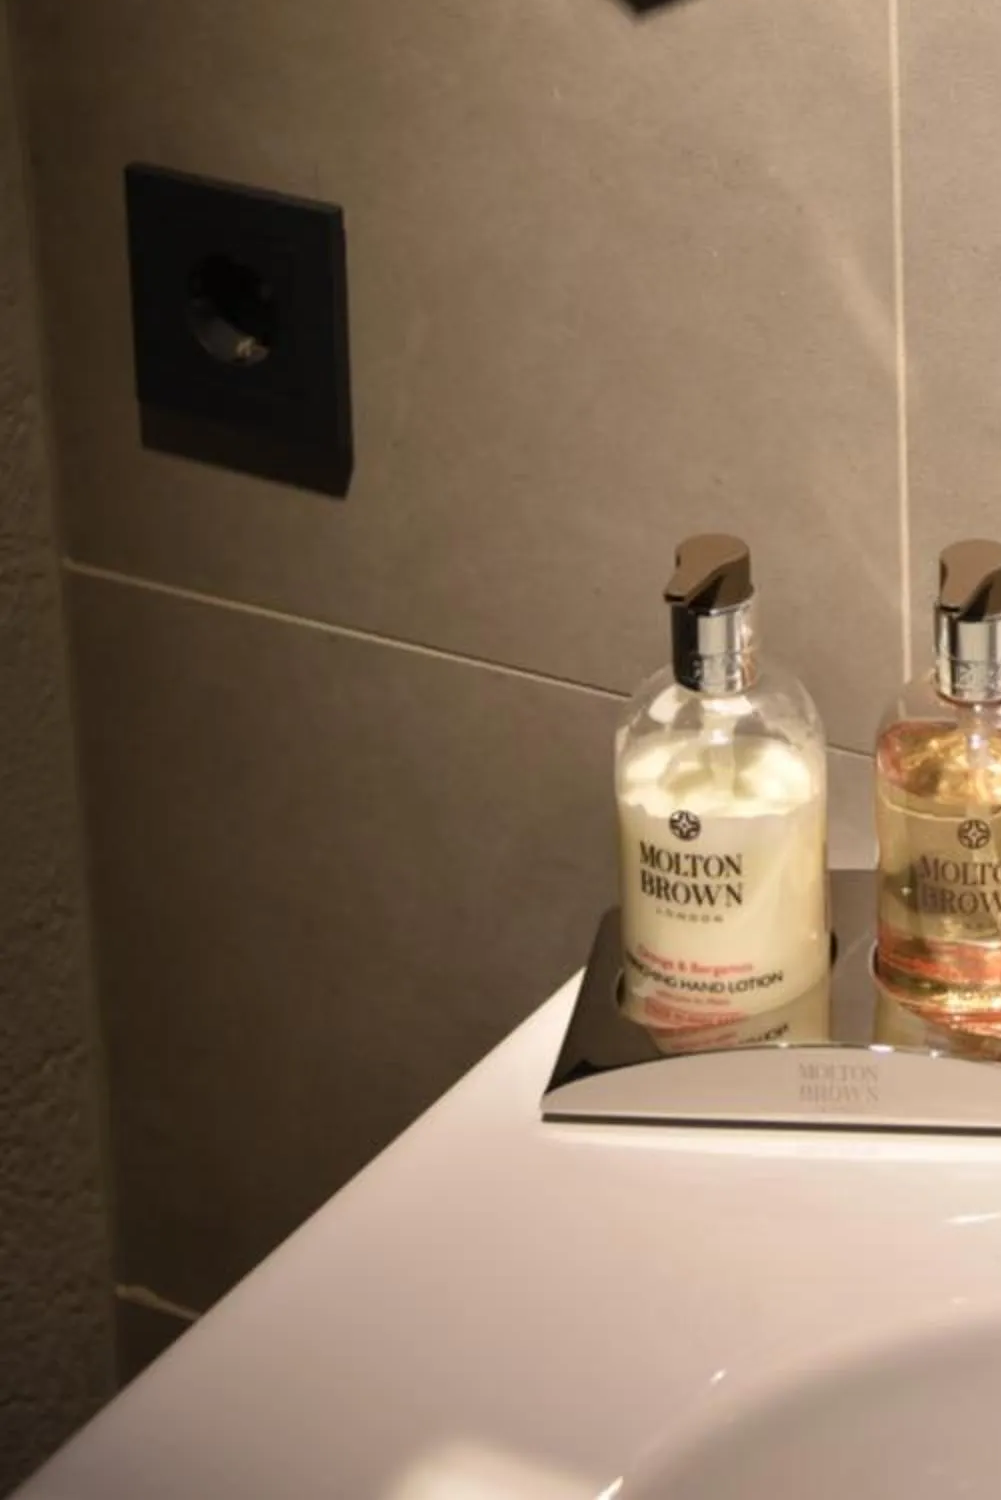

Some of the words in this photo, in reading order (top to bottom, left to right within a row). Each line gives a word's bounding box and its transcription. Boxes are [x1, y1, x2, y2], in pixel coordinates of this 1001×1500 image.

[639, 840, 743, 878] MOLTON
[639, 868, 744, 909] BROWN
[680, 979, 726, 995] HAND
[727, 969, 784, 996] LOTION
